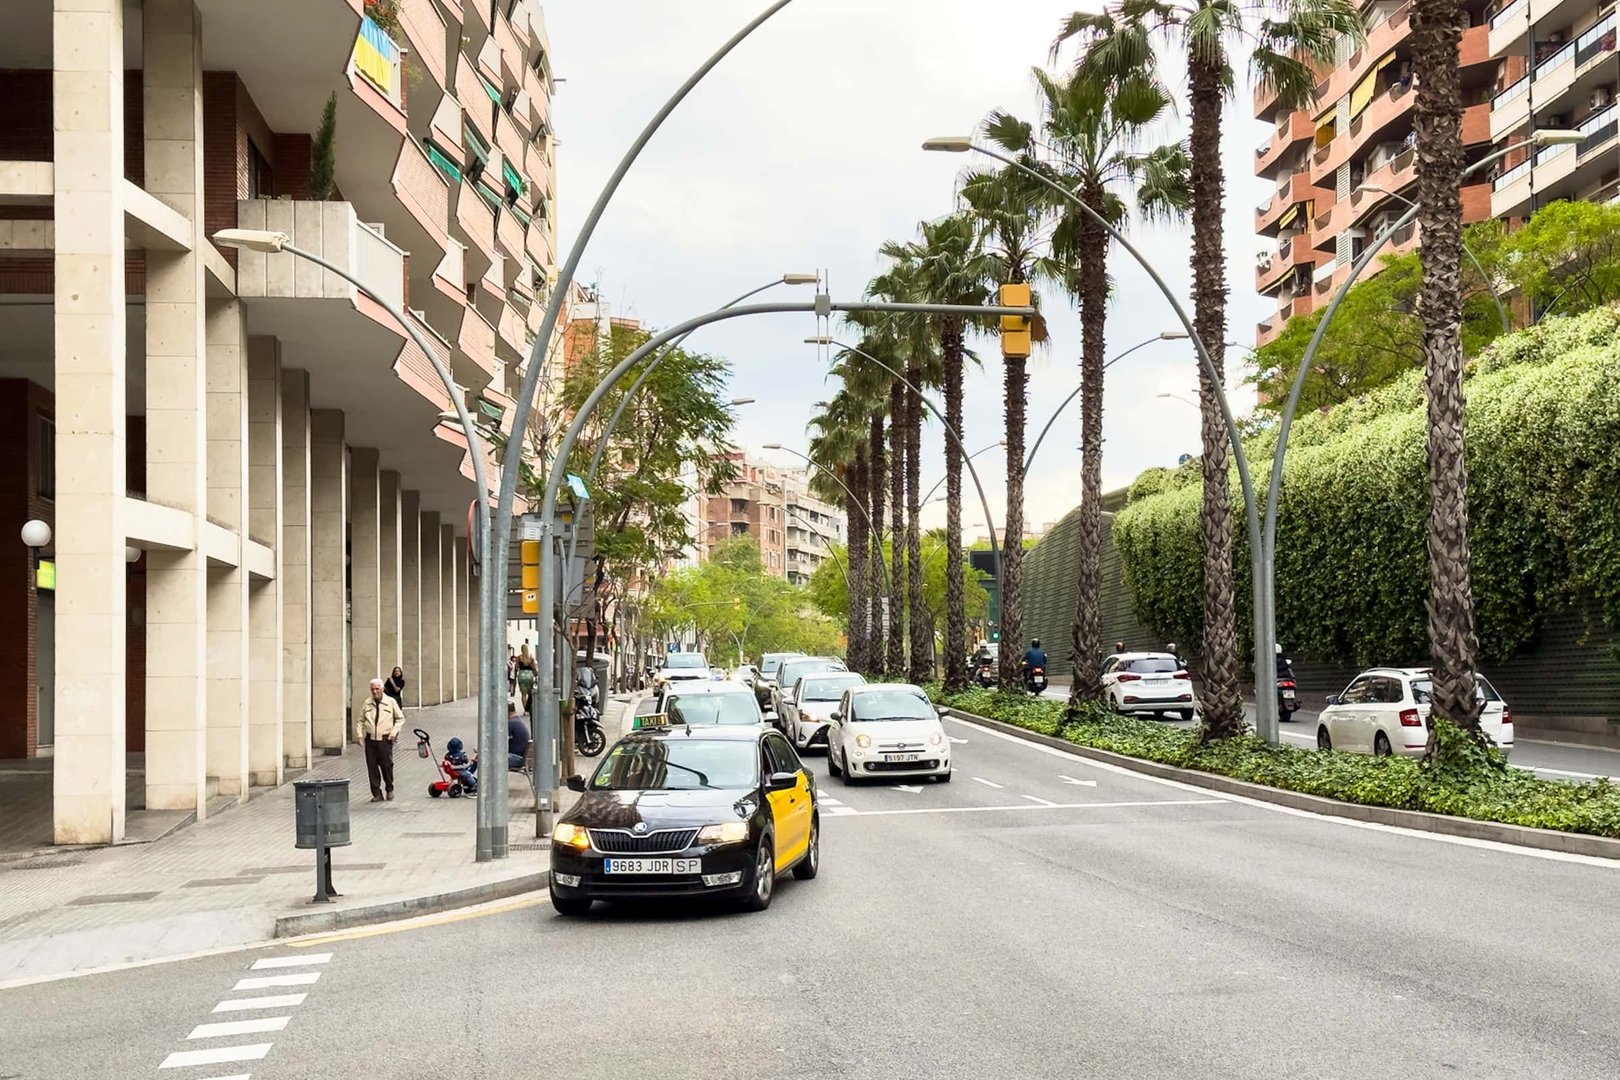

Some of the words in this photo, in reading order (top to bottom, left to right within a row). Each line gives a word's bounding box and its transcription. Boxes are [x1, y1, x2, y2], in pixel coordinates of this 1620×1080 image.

[641, 716, 657, 727] TAXI
[612, 860, 642, 872] 9683
[647, 860, 669, 872] JDR
